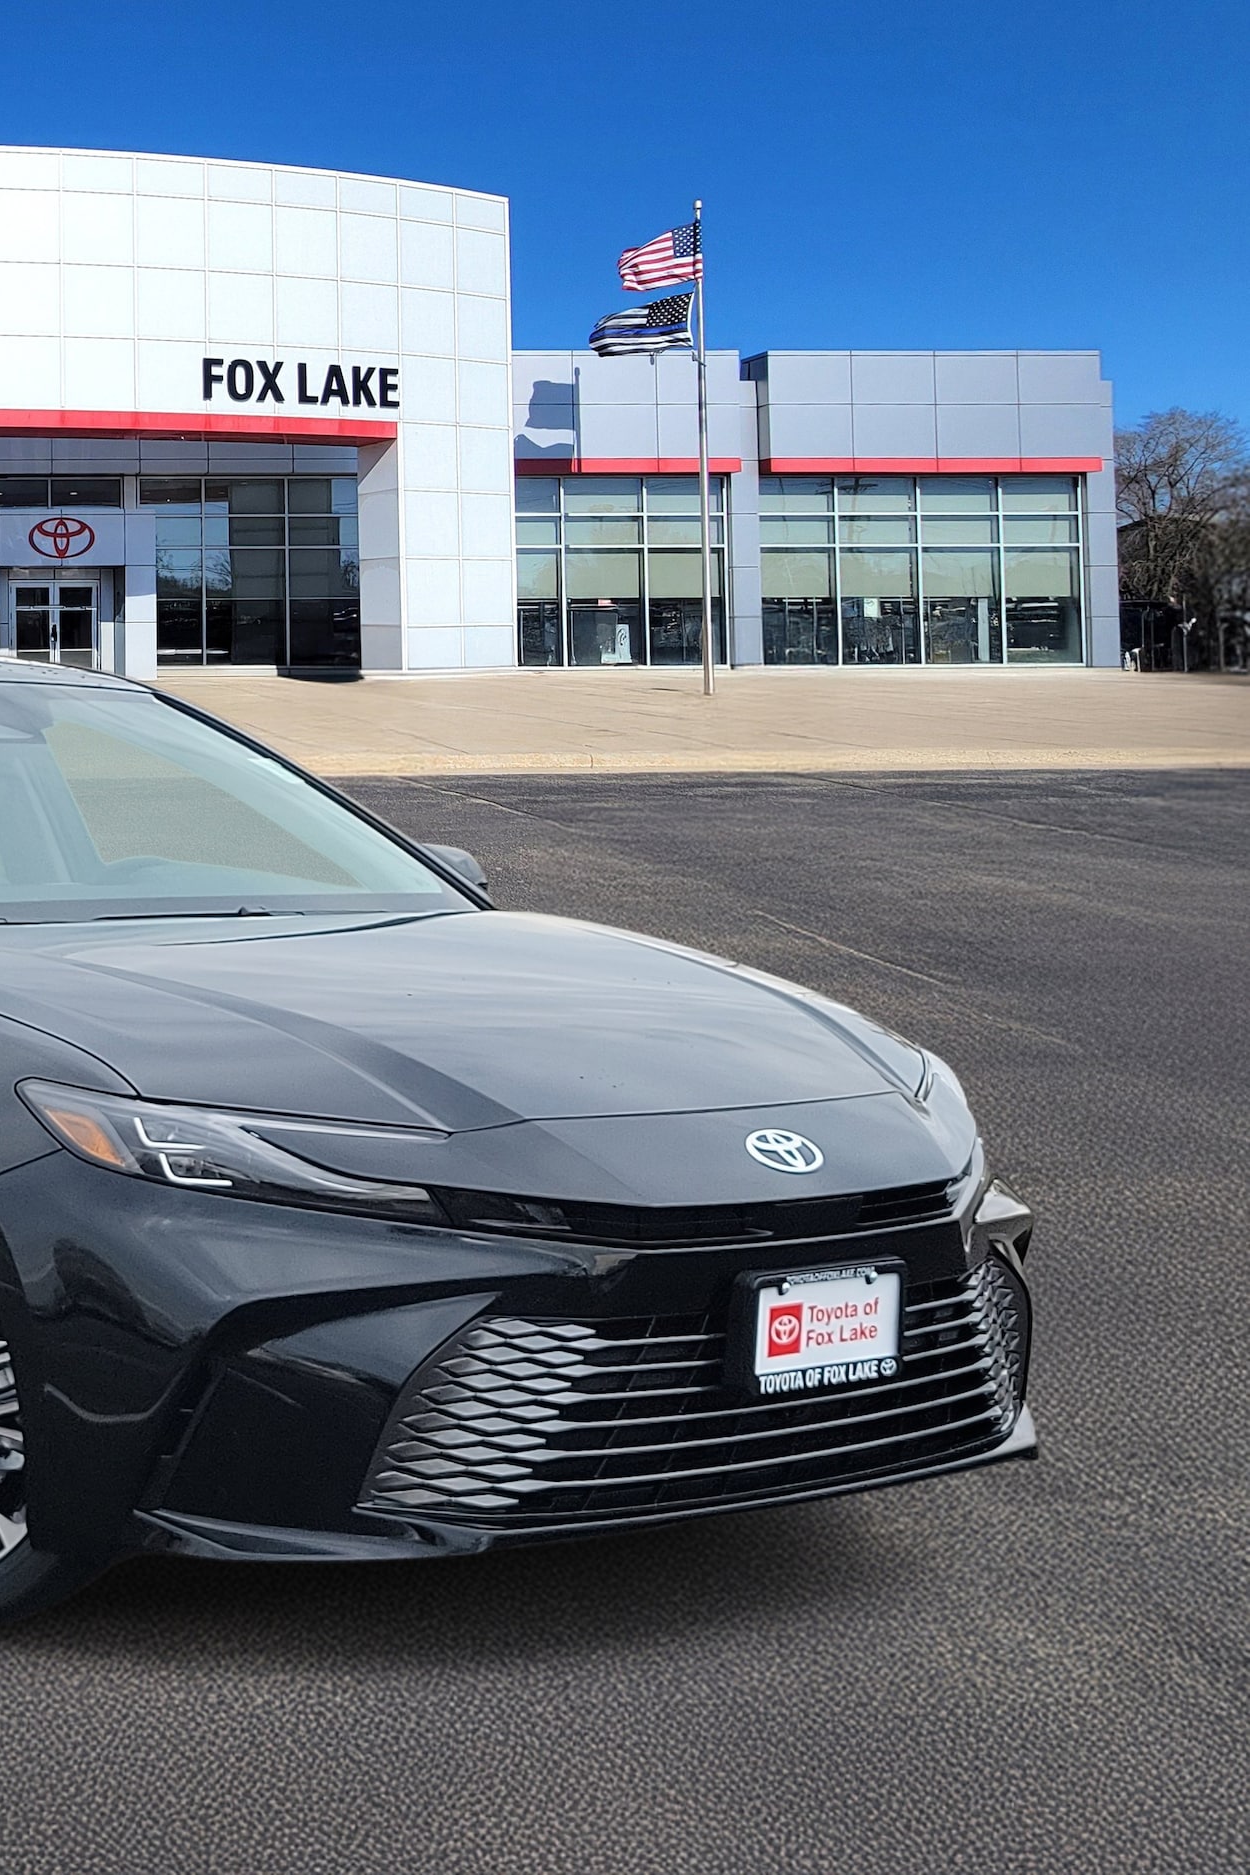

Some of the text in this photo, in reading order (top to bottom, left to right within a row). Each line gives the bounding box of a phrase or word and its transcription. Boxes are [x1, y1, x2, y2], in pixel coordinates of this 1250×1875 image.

[203, 358, 400, 408] FOX LAKE
[807, 1297, 879, 1326] Toyota of
[806, 1322, 878, 1347] Fox Lake
[759, 1360, 879, 1394] TOYOTA OF FOX LAKE
